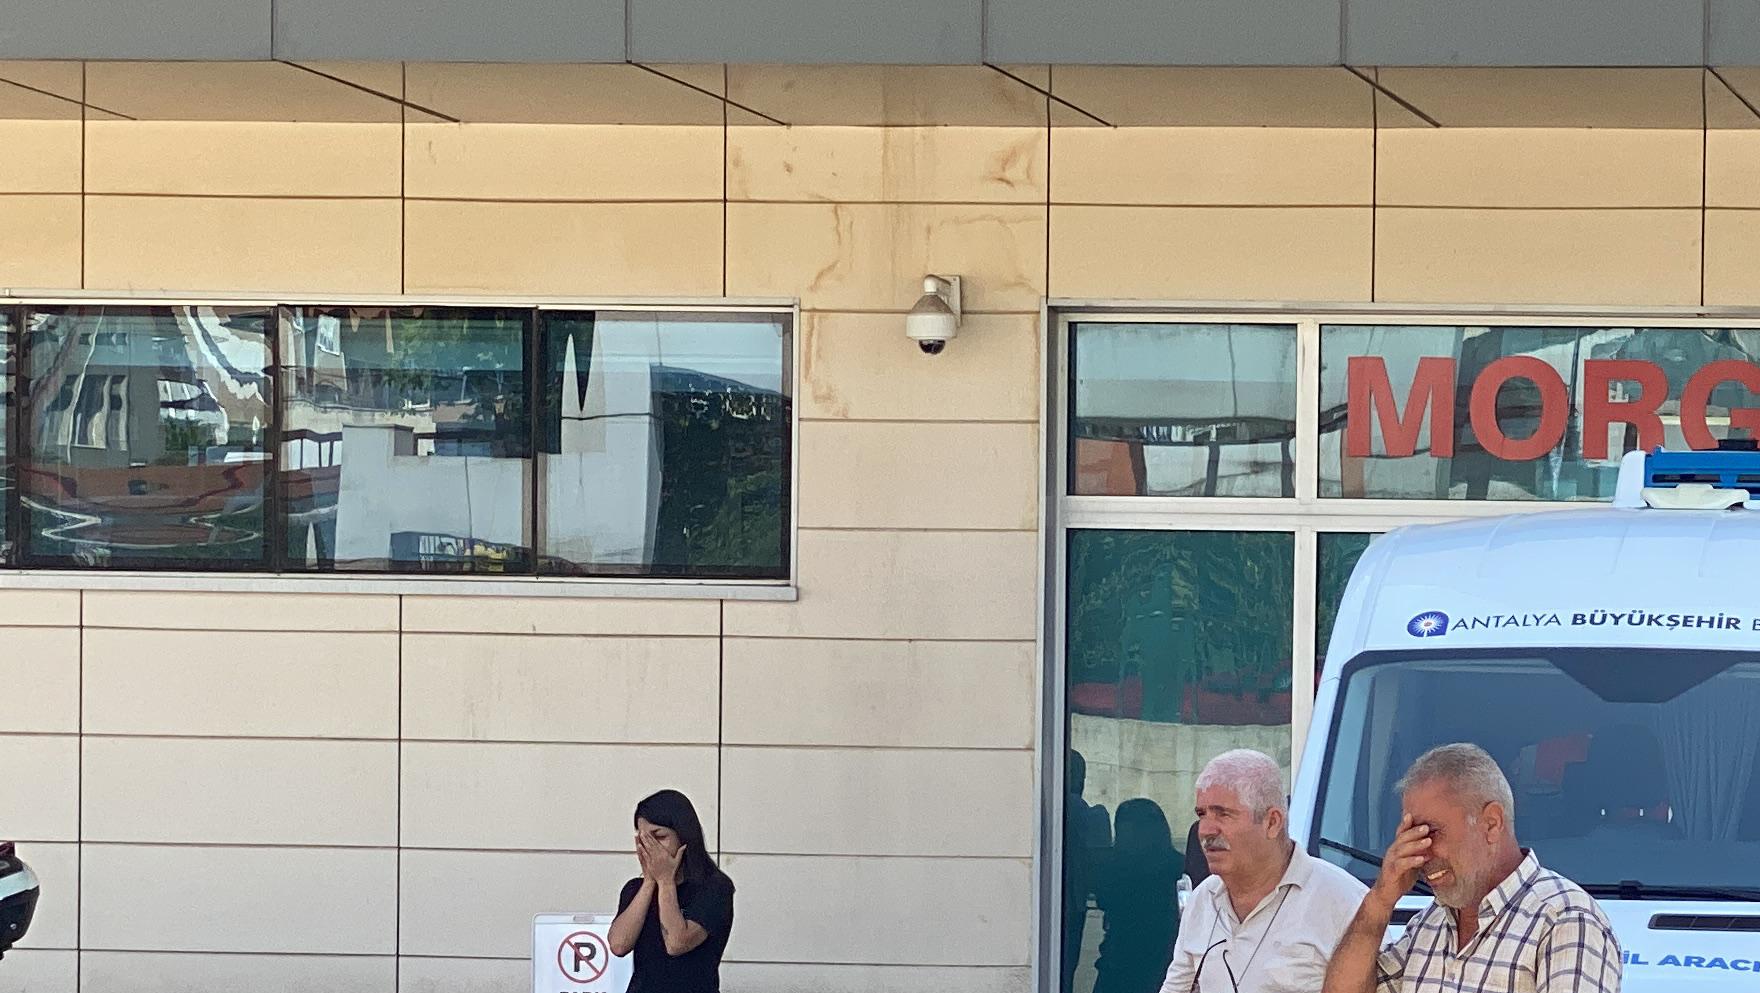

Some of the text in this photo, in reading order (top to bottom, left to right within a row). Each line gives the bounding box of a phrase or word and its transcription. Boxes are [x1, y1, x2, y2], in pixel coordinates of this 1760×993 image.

[1451, 612, 1561, 631] ANTALYA
[1571, 610, 1741, 631] BÜYÜKŞEHİR
[1657, 954, 1760, 972] ARACI
